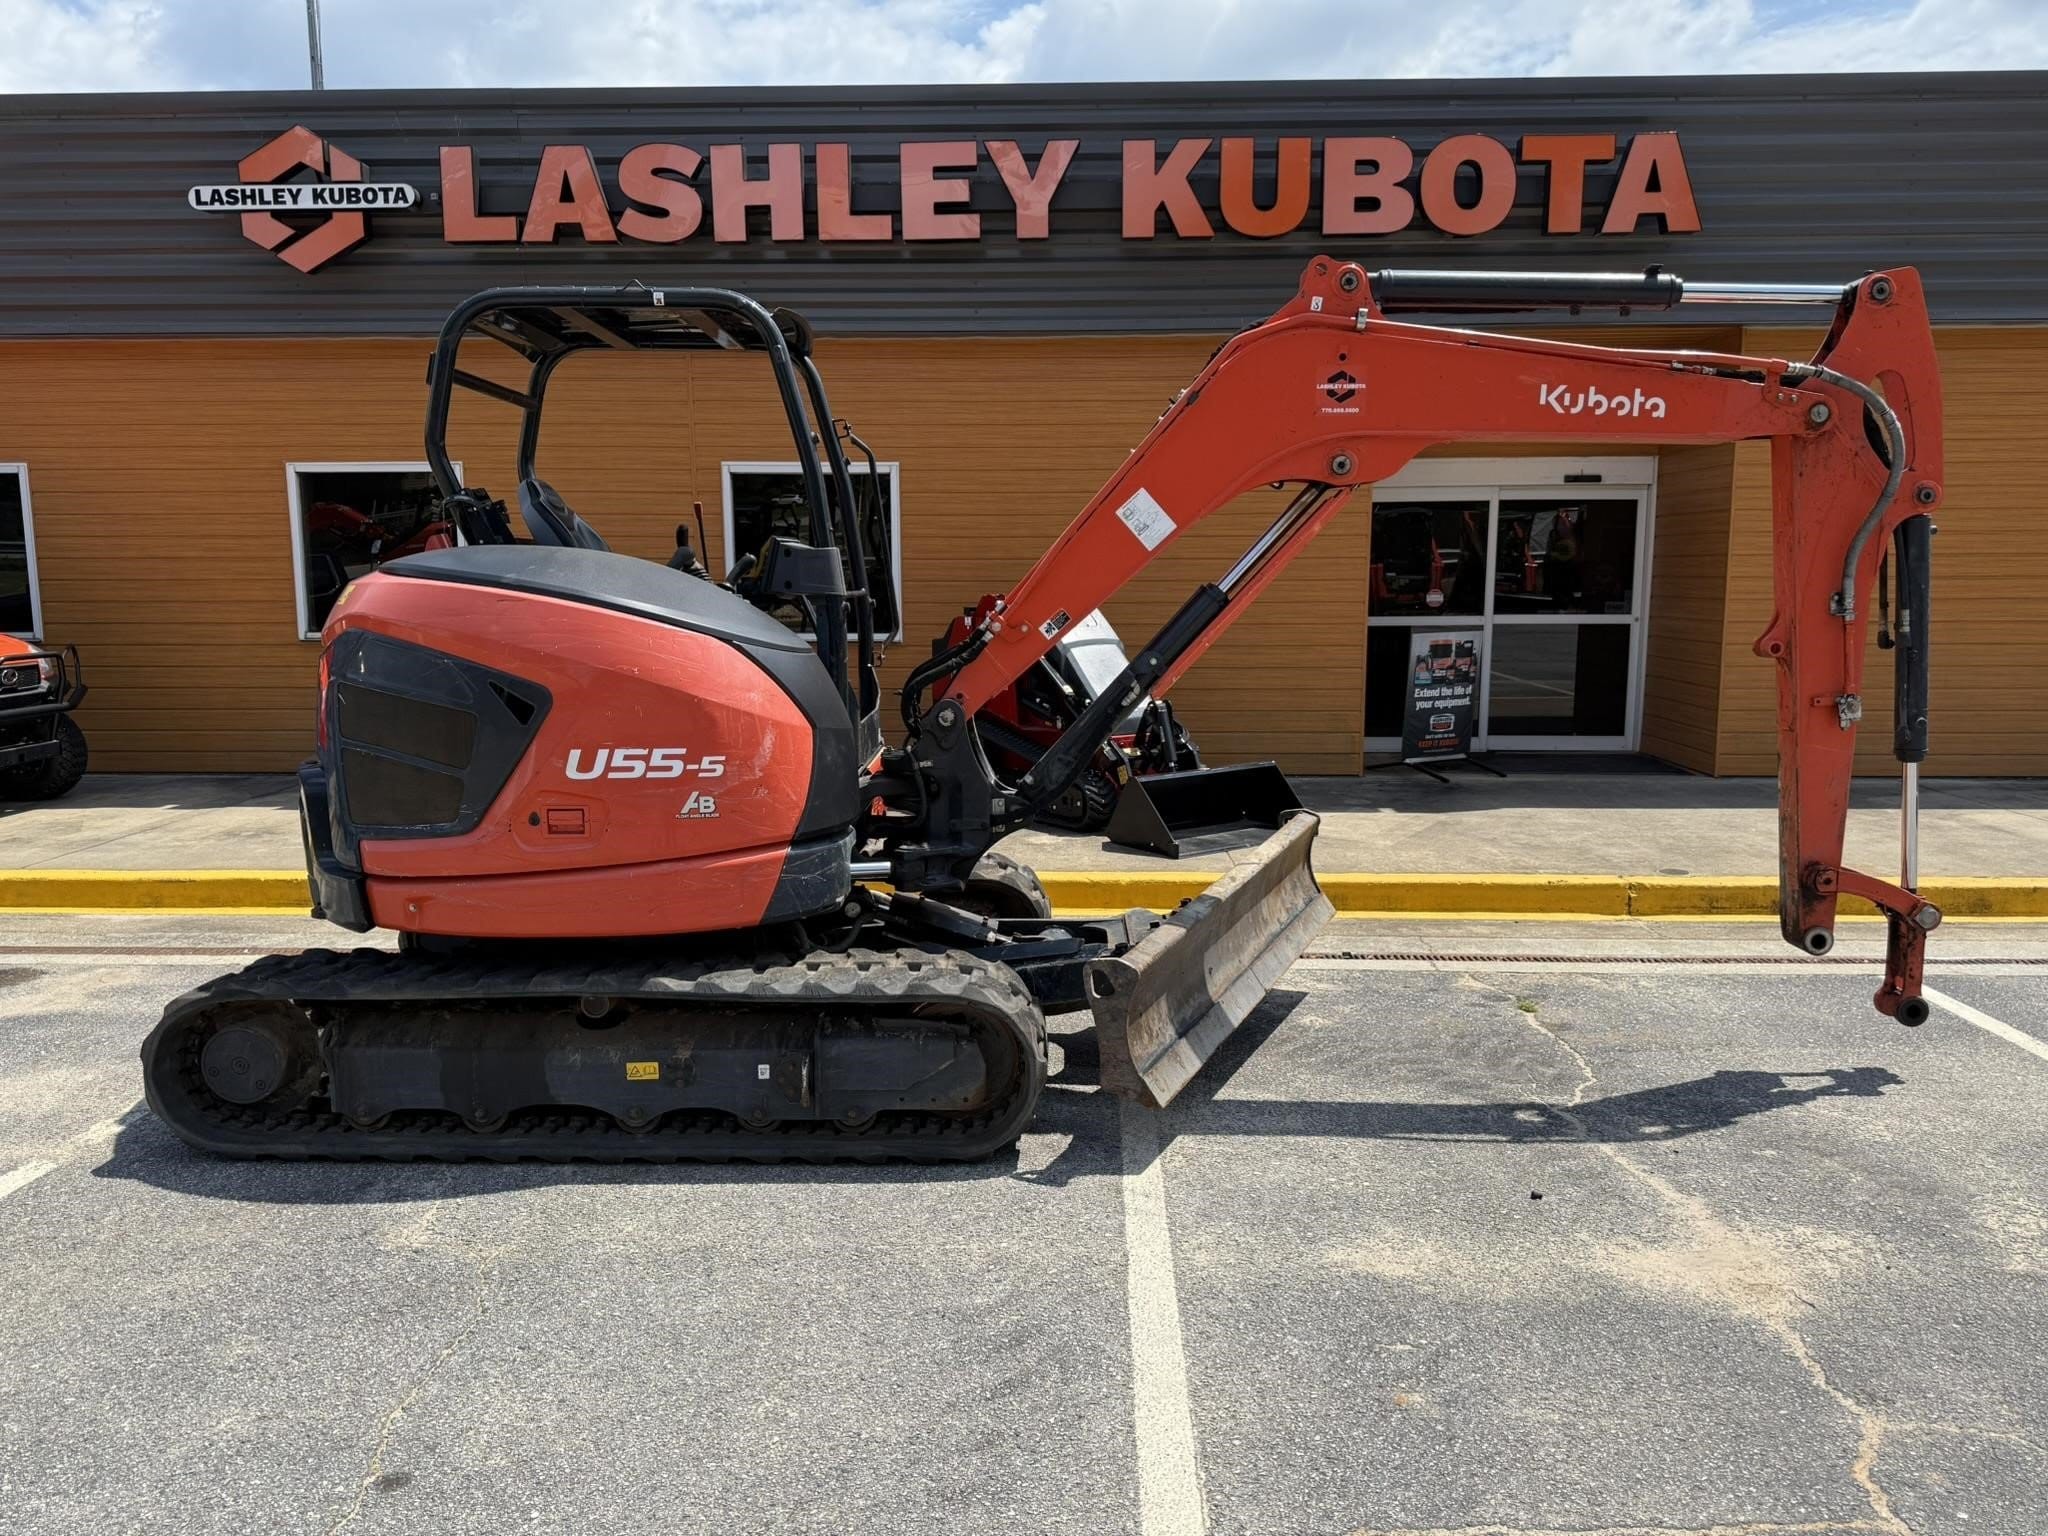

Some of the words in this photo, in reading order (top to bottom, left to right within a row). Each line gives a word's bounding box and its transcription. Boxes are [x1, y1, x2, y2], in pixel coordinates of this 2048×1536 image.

[194, 187, 302, 206] LASHLEY
[312, 186, 409, 205] KUBOTA
[439, 138, 1081, 243] LASHLEY
[1121, 131, 1703, 239] KUBOTA
[1539, 383, 1666, 418] Kubota
[1414, 687, 1440, 698] Extend
[1440, 686, 1453, 696] the
[1453, 685, 1465, 695] life
[1465, 684, 1472, 695] of
[1415, 700, 1434, 711] your
[1434, 696, 1471, 709] equipment.
[565, 747, 726, 780] U55-5
[680, 791, 716, 814] AB
